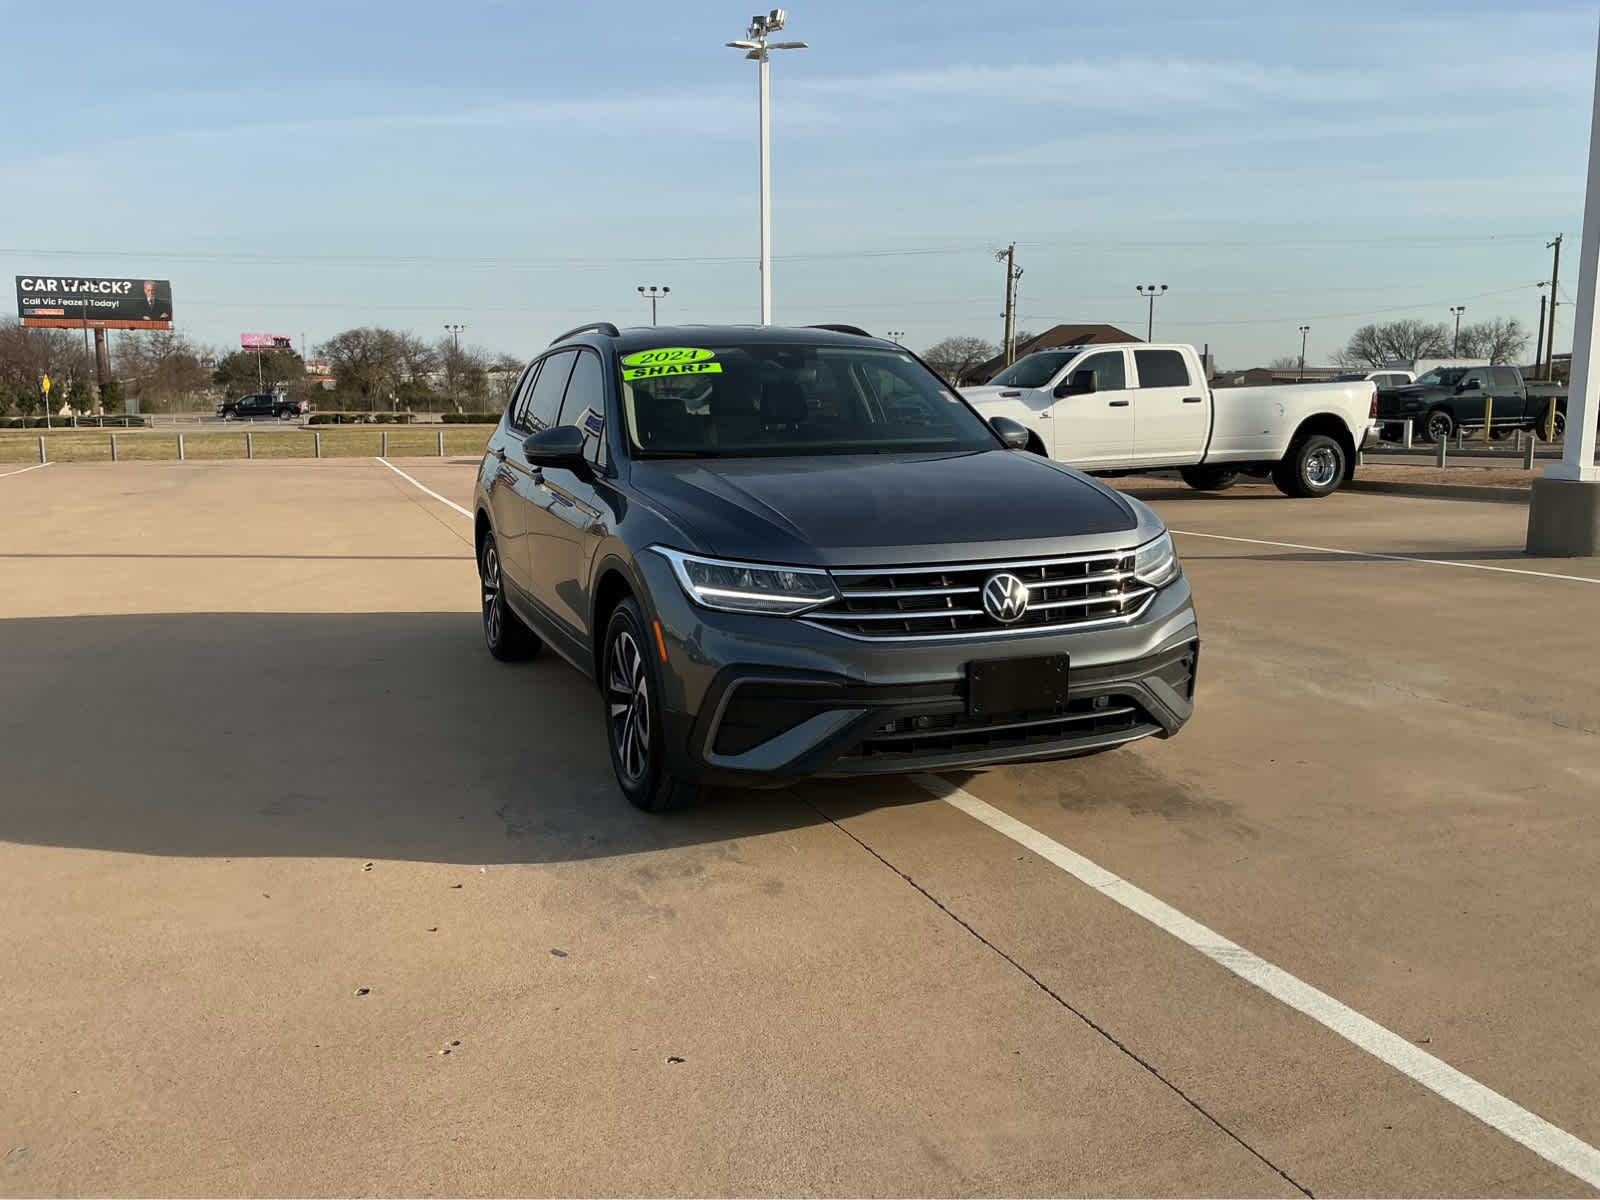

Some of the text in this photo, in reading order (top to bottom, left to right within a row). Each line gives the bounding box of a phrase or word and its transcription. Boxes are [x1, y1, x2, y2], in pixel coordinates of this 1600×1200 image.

[21, 279, 132, 294] CAR WRECK?
[90, 299, 119, 308] Today!
[641, 350, 698, 364] 2024
[633, 364, 710, 377] SHARP
